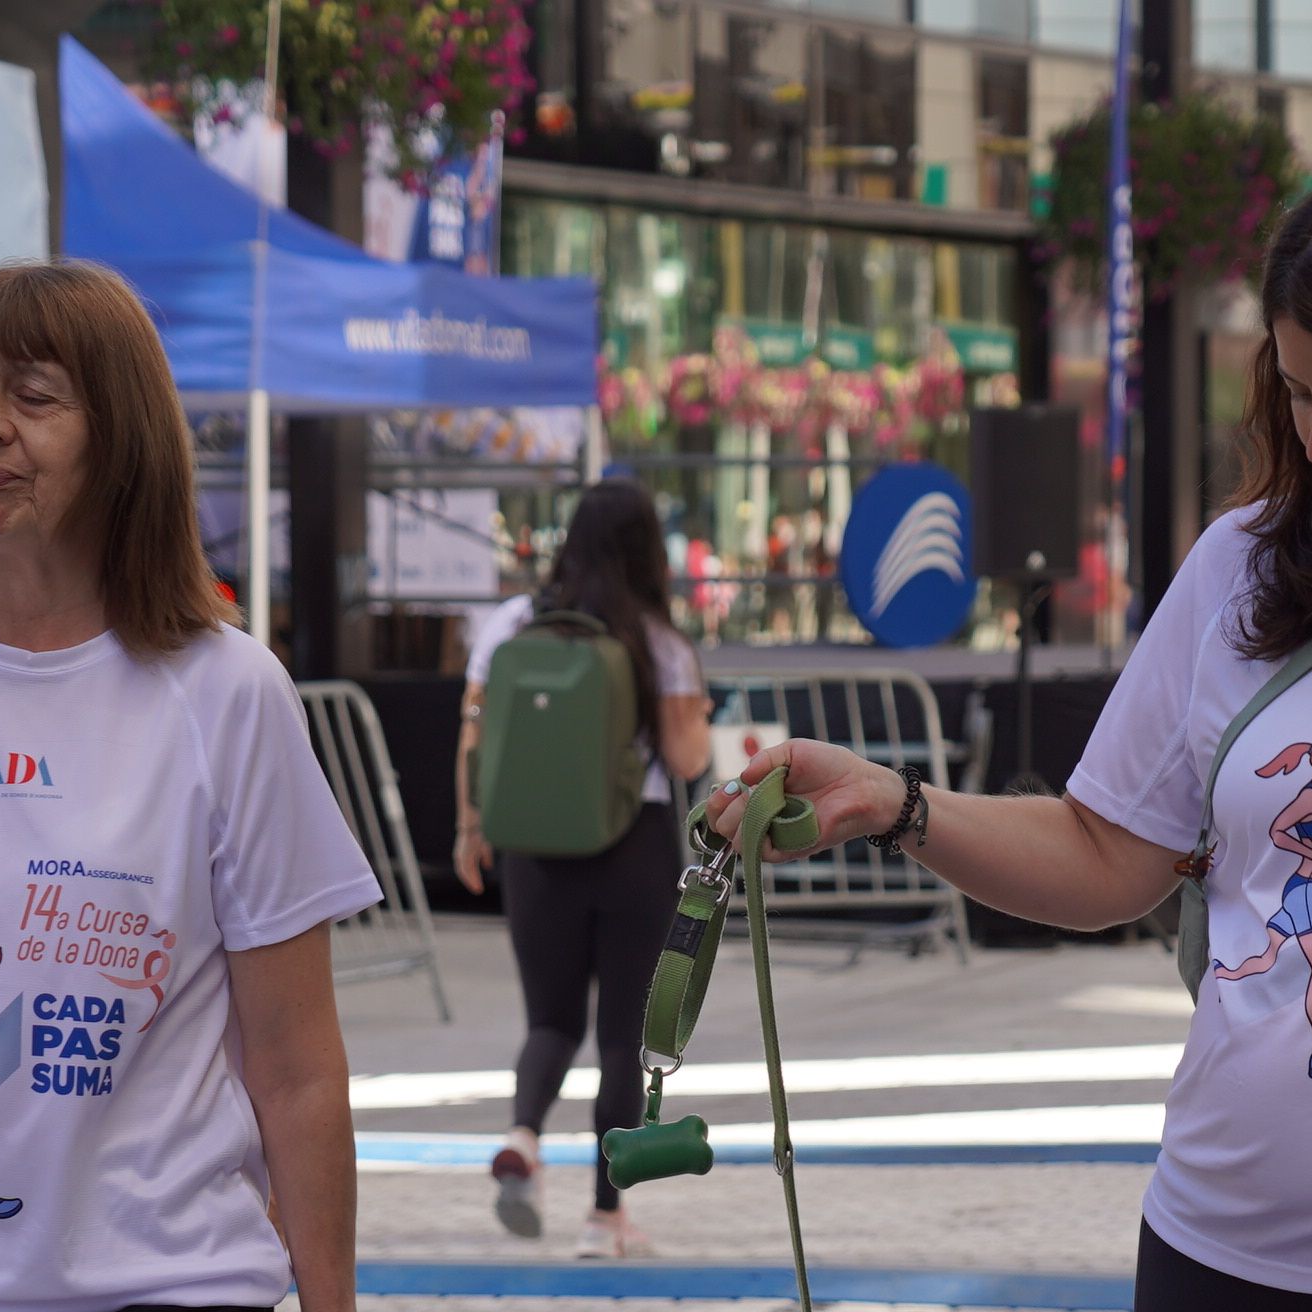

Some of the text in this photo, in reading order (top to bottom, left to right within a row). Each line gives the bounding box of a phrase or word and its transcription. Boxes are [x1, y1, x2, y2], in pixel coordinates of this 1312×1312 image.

[27, 860, 154, 885] MORA ASSEGURANCES
[77, 902, 149, 936] Cursa
[17, 935, 139, 969] de la Dona
[33, 993, 125, 1024] CADA
[31, 1025, 122, 1060] PAS
[31, 1063, 113, 1096] SUMA
